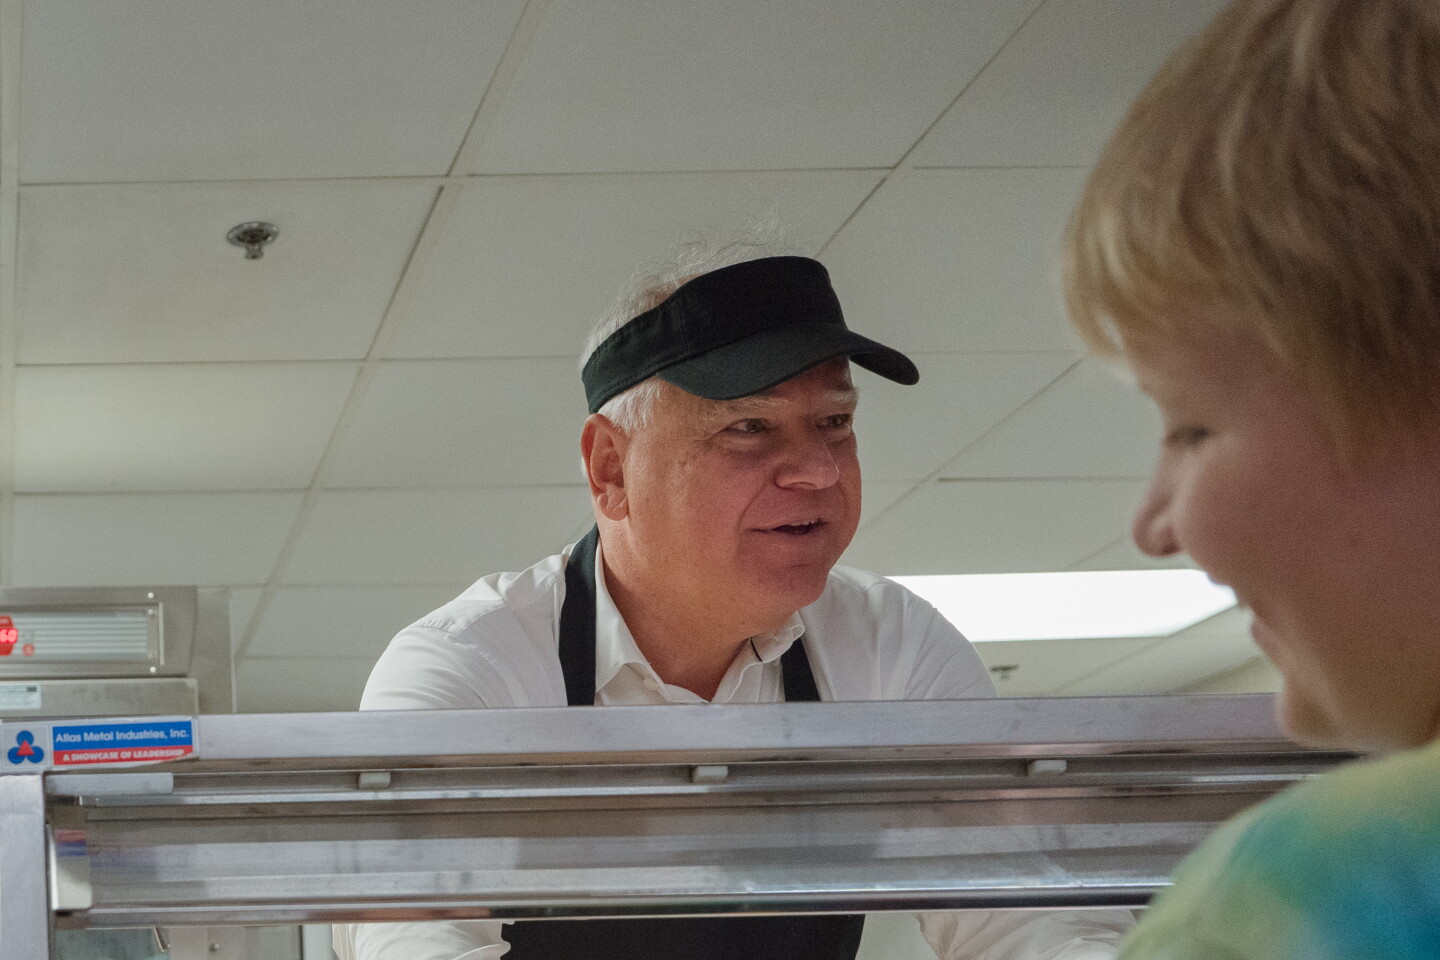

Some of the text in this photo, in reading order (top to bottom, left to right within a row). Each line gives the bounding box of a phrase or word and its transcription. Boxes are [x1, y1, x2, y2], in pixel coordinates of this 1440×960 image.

[55, 728, 190, 743] Atlas Metal Industries, Inc.
[63, 748, 185, 761] A SHOWCASE OF LEADERSHIP
